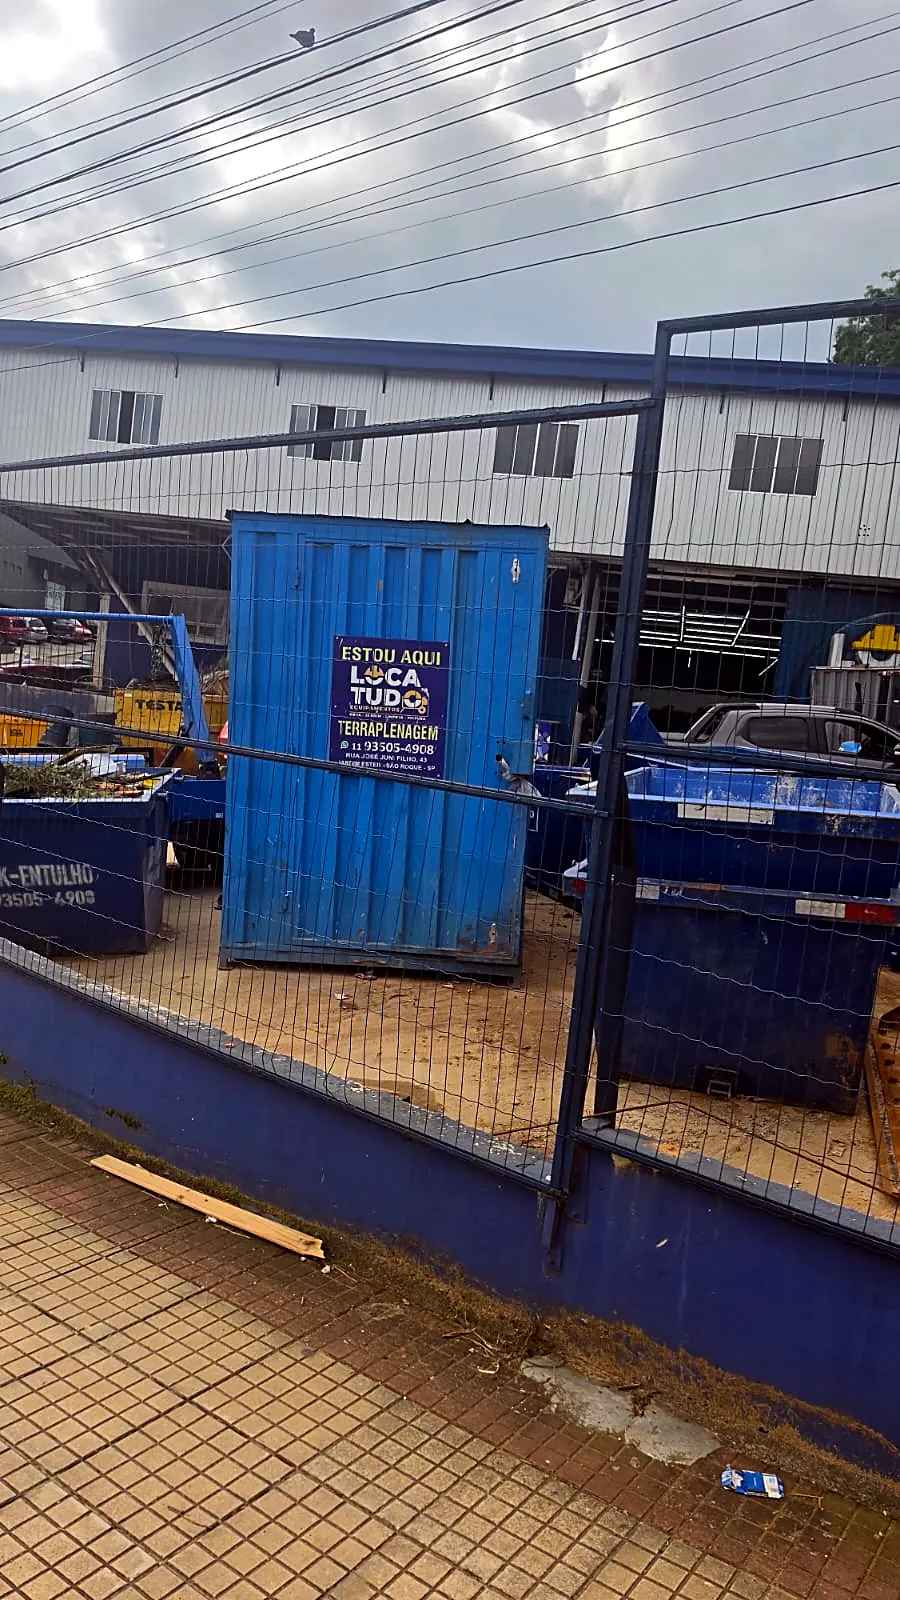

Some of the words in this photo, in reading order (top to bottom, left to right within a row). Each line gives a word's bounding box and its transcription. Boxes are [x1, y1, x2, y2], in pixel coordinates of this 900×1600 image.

[342, 646, 396, 663] ESTOU
[400, 650, 441, 666] AQUI
[350, 665, 422, 688] LOCA
[350, 686, 424, 709] TUDO
[338, 720, 440, 741] TERRAPLENAGEM
[351, 742, 362, 751] 11
[364, 741, 434, 755] 93505-4908
[0, 889, 95, 908] 3505-4908
